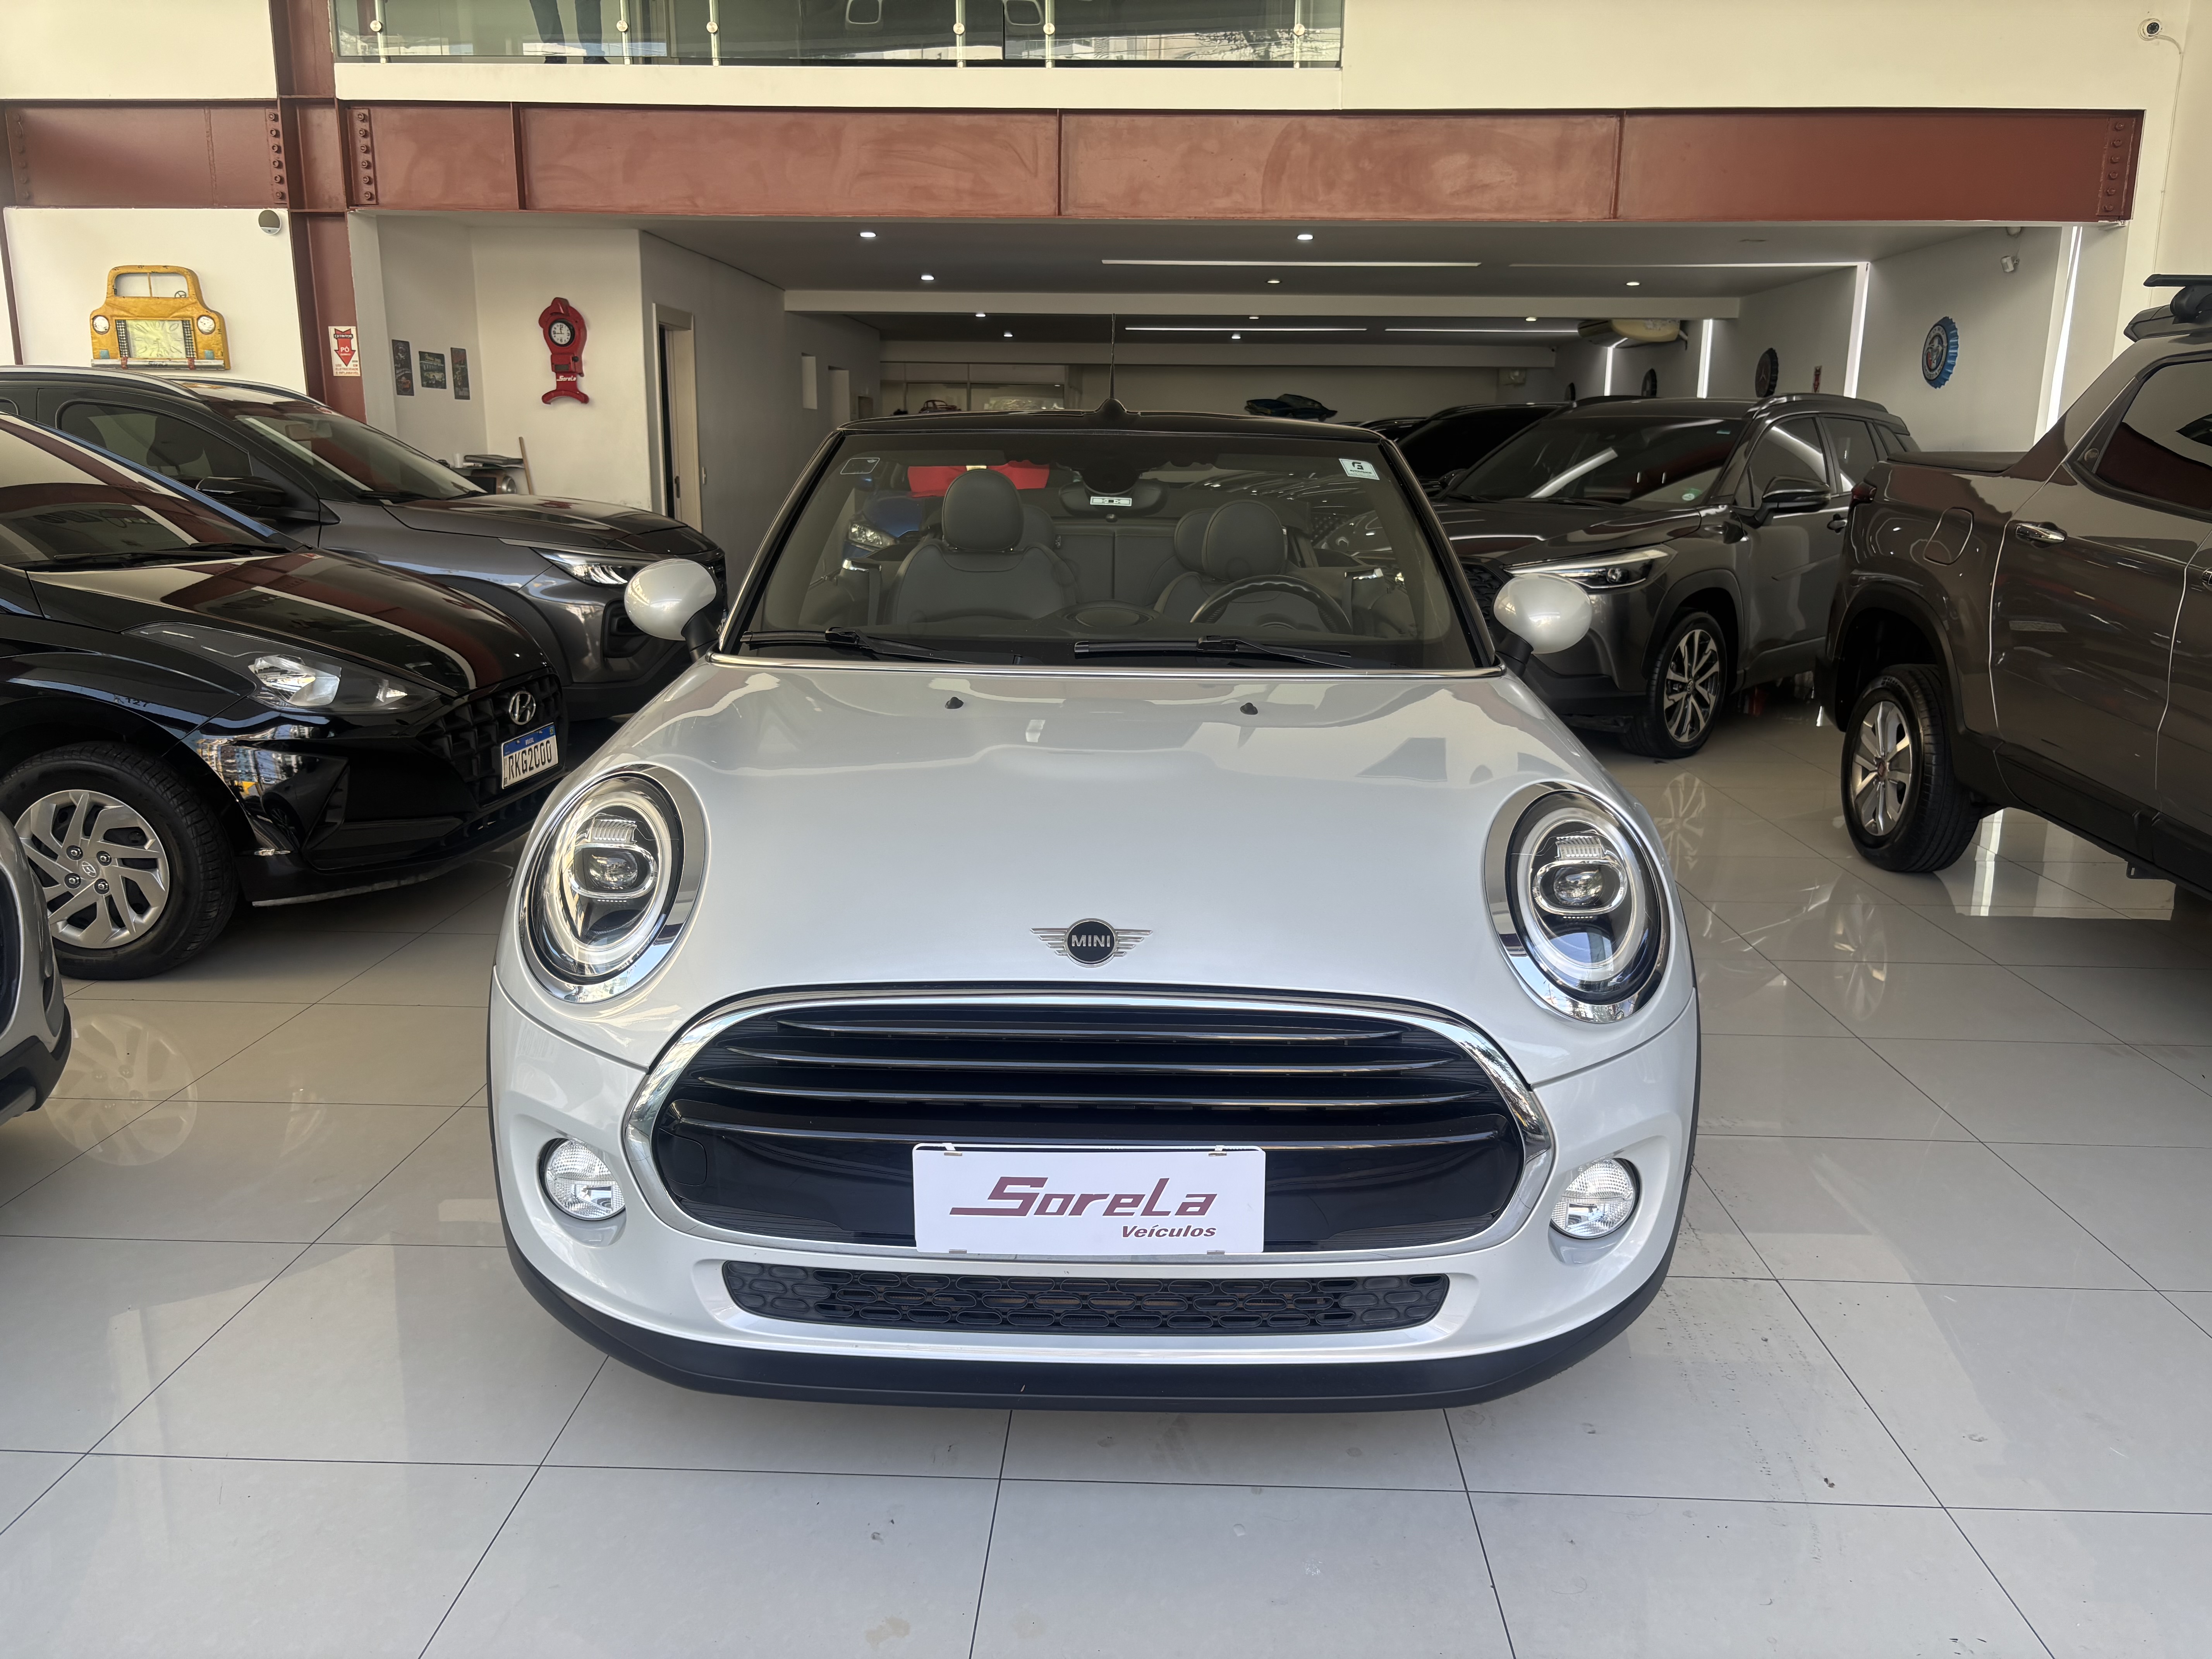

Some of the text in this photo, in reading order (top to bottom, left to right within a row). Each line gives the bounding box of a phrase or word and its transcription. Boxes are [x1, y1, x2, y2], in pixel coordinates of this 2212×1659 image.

[526, 737, 534, 745] BRASIL
[1072, 935, 1110, 947] MINI
[1123, 1224, 1217, 1238] Veículos
